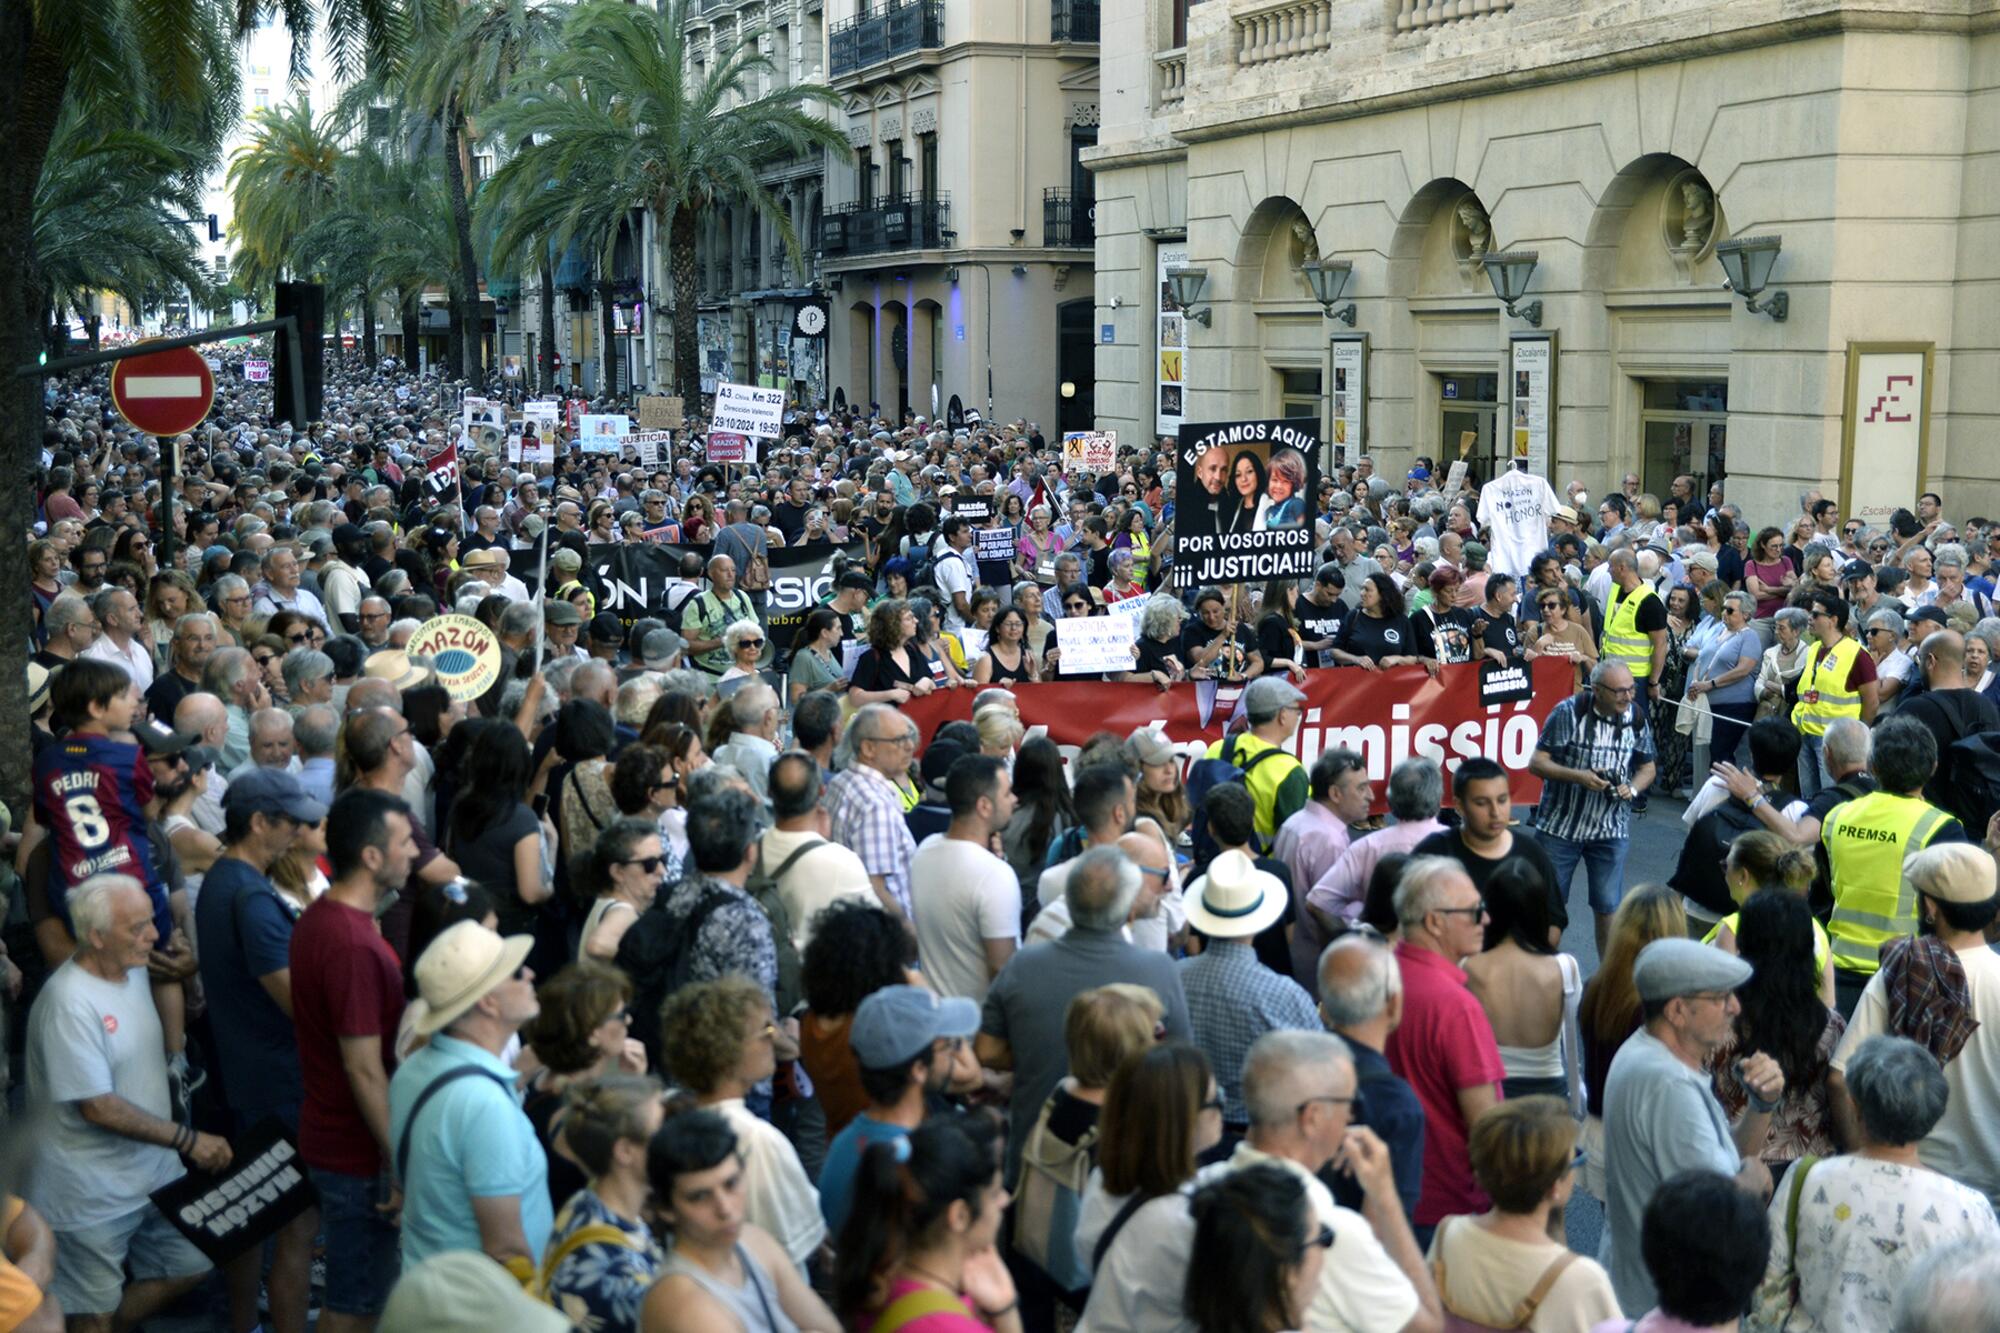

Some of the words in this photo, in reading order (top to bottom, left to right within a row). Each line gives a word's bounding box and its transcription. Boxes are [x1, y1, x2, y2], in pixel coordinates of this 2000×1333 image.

[752, 392, 765, 402] Km
[766, 393, 782, 404] 322
[752, 408, 774, 416] Valencia
[620, 432, 668, 444] JUSTICIA
[759, 422, 779, 434] 19:50
[1184, 424, 1266, 466] ESTAMOS
[1271, 425, 1315, 453] AQUÍ
[1506, 504, 1542, 524] HONOR
[1860, 505, 1898, 516] Escalan
[988, 540, 1012, 549] CULPABLE
[1179, 536, 1213, 553] POR
[1219, 529, 1309, 550] VOSOTROS
[1197, 551, 1312, 580] JUSTICIA!!!
[417, 626, 489, 656] MAZÓN
[1487, 667, 1523, 683] MAZÓN
[1483, 676, 1528, 695] DIMISSIÓ
[52, 772, 100, 796] PEDRI
[66, 794, 110, 848] 8
[1838, 824, 1897, 844] PREMSA
[180, 1138, 296, 1228] DIMISSIÓ
[206, 1164, 303, 1237] MAZÓN
